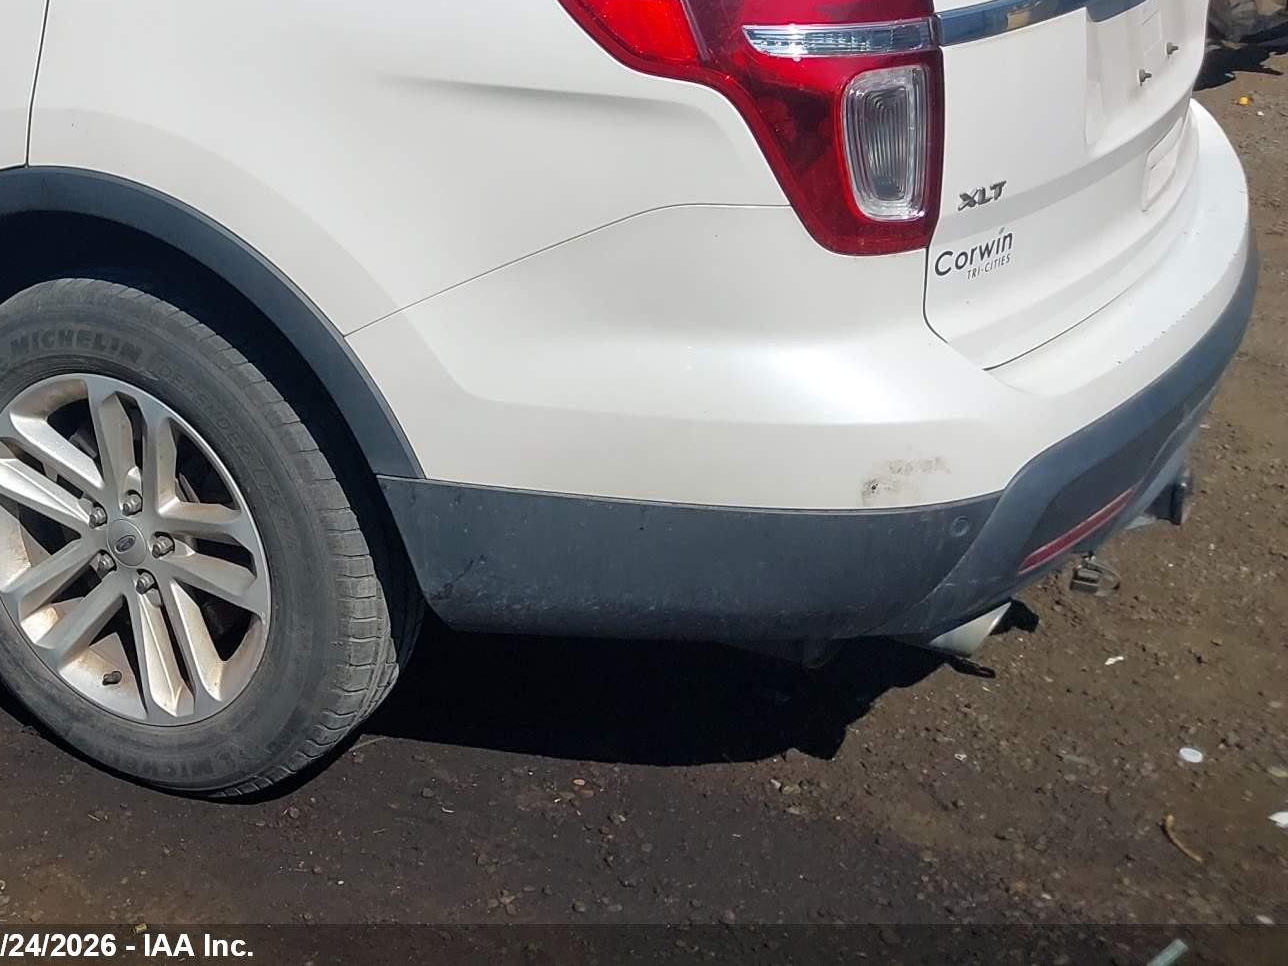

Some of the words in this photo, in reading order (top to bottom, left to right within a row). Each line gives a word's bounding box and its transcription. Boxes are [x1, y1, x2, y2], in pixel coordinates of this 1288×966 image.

[958, 181, 1007, 211] XLT
[935, 227, 1013, 276] Corwin
[10, 327, 142, 365] MICHELIN
